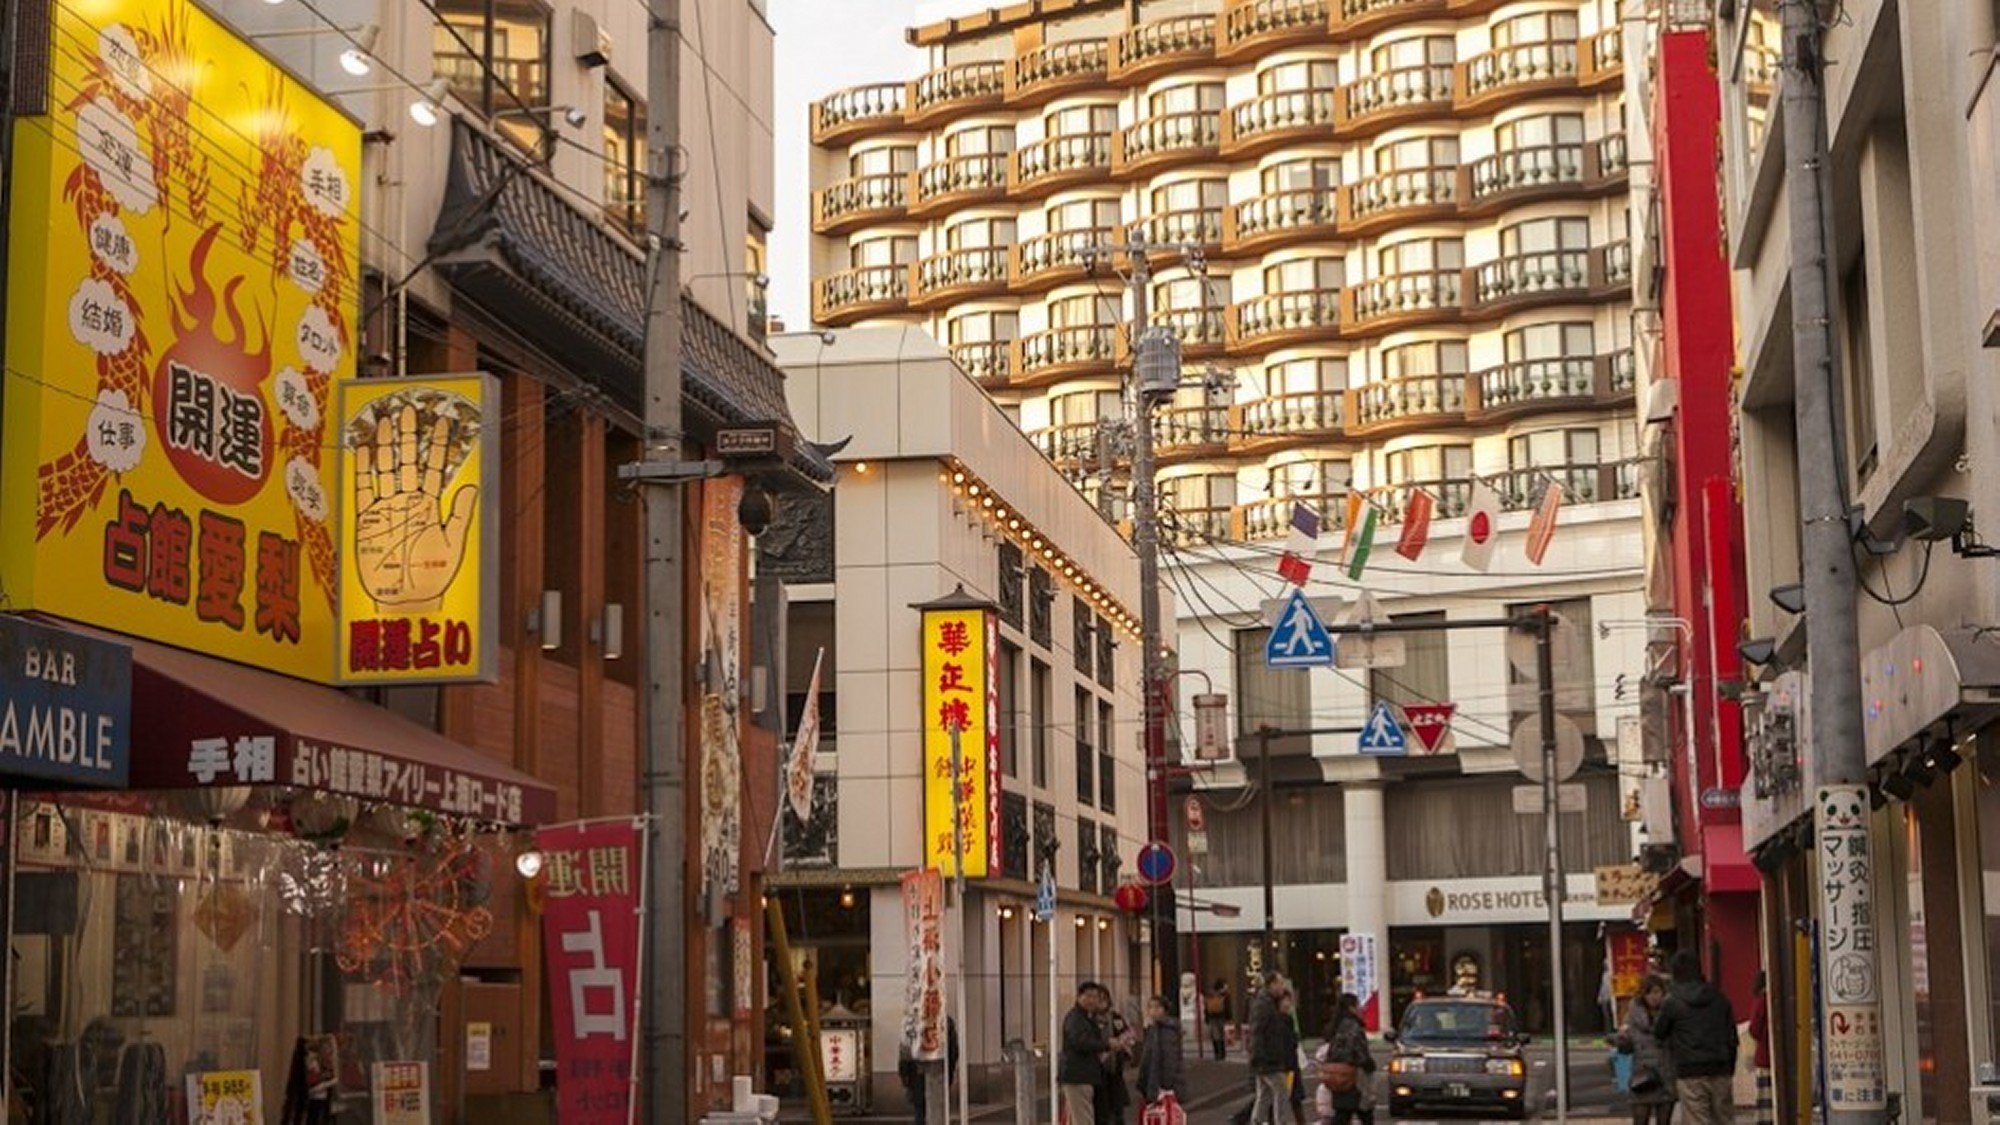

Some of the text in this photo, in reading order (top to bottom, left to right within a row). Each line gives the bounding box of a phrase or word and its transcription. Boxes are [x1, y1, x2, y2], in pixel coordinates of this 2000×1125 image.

[309, 168, 342, 201] 手相
[81, 298, 123, 338] 結婚
[98, 420, 135, 449] 仕事
[169, 363, 262, 478] 開運
[104, 488, 301, 645] 占館愛梨
[25, 647, 77, 686] BAR
[350, 617, 472, 673] 開運占い
[0, 698, 112, 770] AMBLE
[187, 735, 276, 783] 手相
[1447, 893, 1493, 910] ROSE
[1496, 891, 1545, 909] HOTE
[1822, 835, 1848, 951] マッサージ
